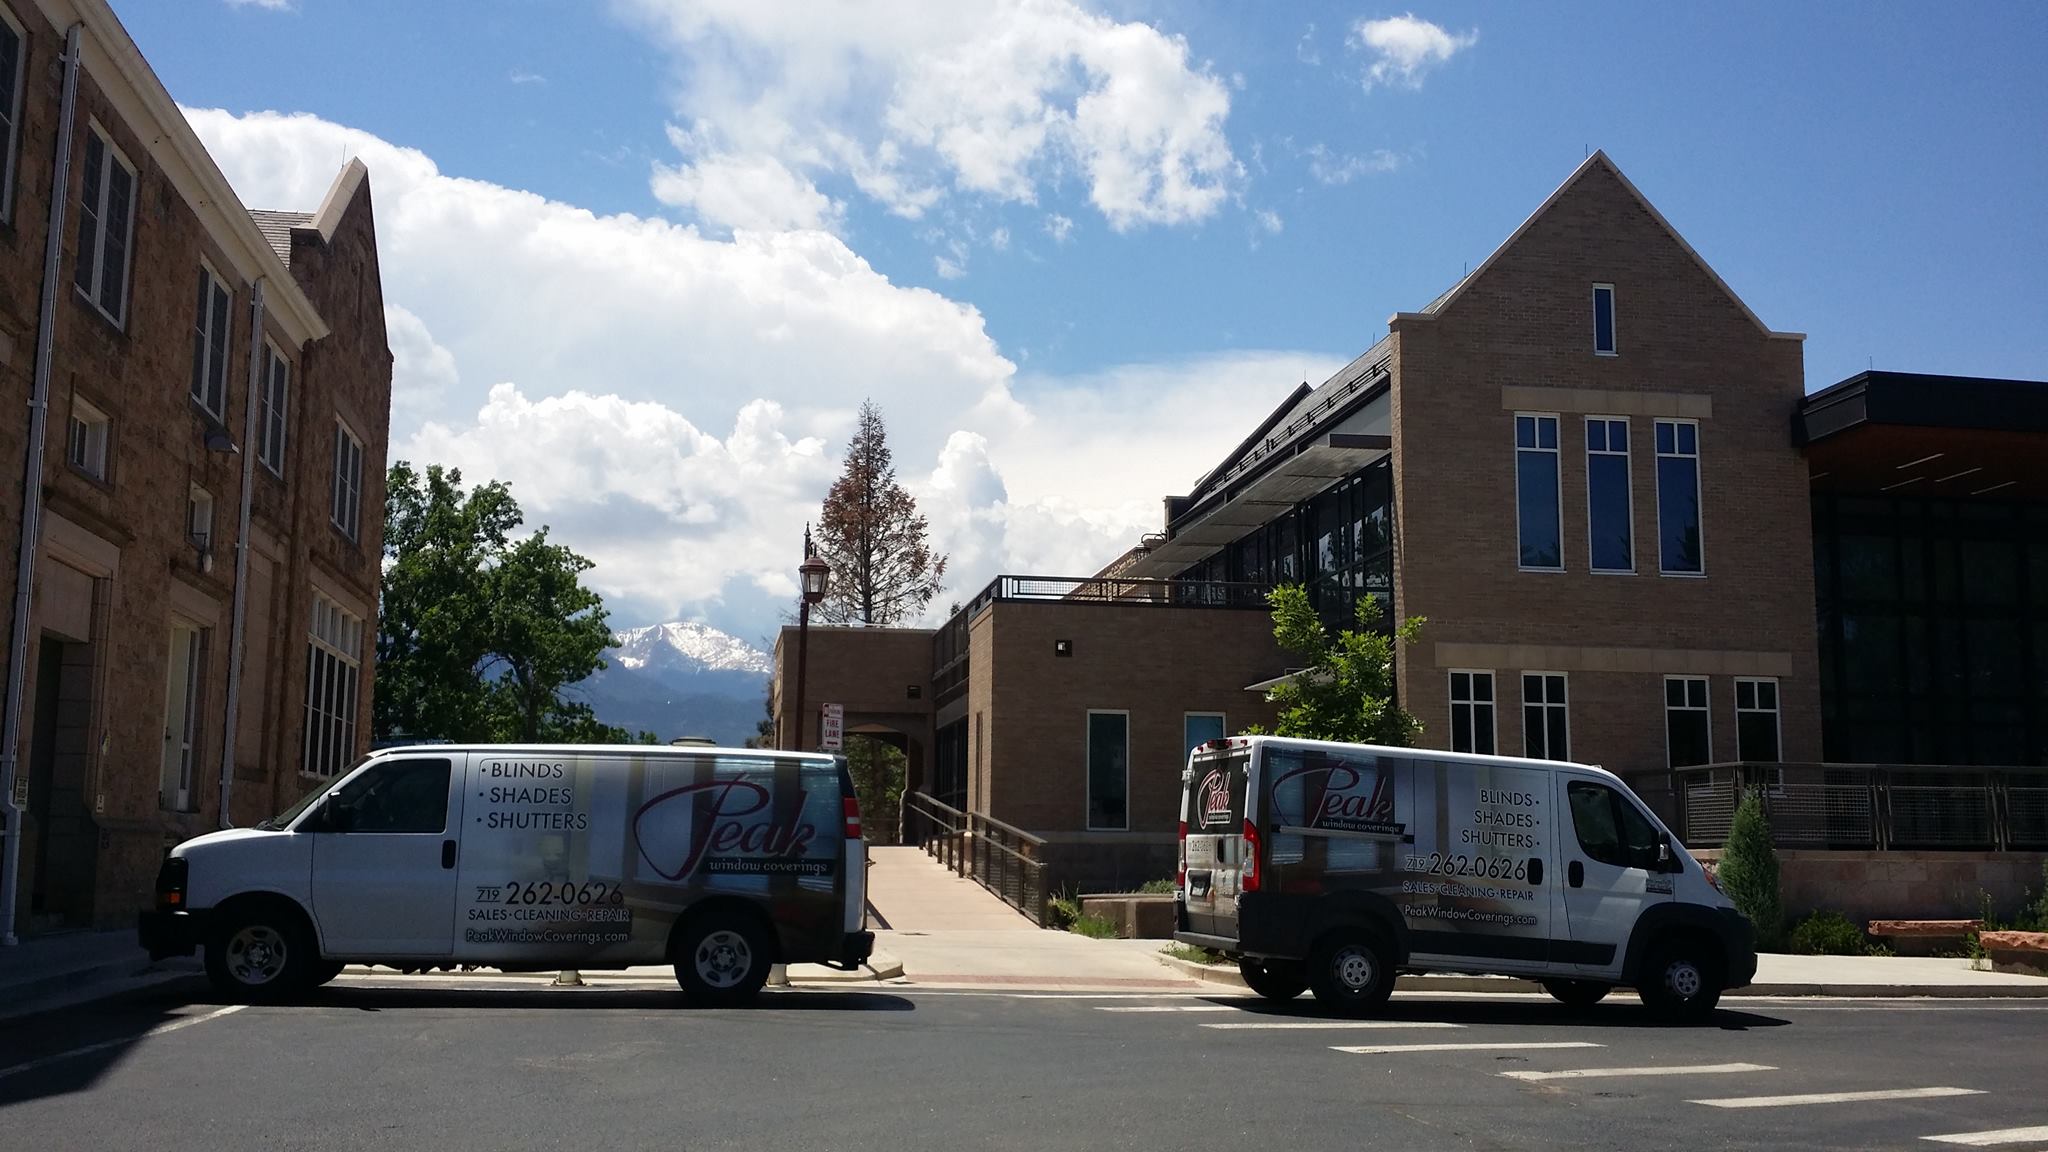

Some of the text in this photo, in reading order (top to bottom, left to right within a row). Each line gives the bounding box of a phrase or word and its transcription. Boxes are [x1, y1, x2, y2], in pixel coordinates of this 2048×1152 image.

[826, 719, 839, 728] FIRE
[825, 730, 839, 739] LANE
[491, 762, 563, 779] BLINDS
[489, 787, 572, 805] SHADES
[1197, 768, 1231, 830] Peak
[1272, 759, 1392, 829] Peak
[1480, 789, 1533, 807] BLINDS
[487, 812, 588, 830] SHUTTERS
[633, 772, 816, 881] Peak
[1322, 819, 1355, 830] window
[1474, 810, 1533, 828] SHADES
[1461, 829, 1533, 849] SHUTTERS
[709, 858, 827, 876] window coverings
[1406, 857, 1425, 870] 719
[1429, 853, 1526, 881] 262-0626
[477, 889, 500, 900] 719
[505, 881, 624, 905] 262-0626
[1404, 904, 1537, 926] PeakWindowCoverings.com
[466, 928, 628, 944] PeakWindowCoverings.com
